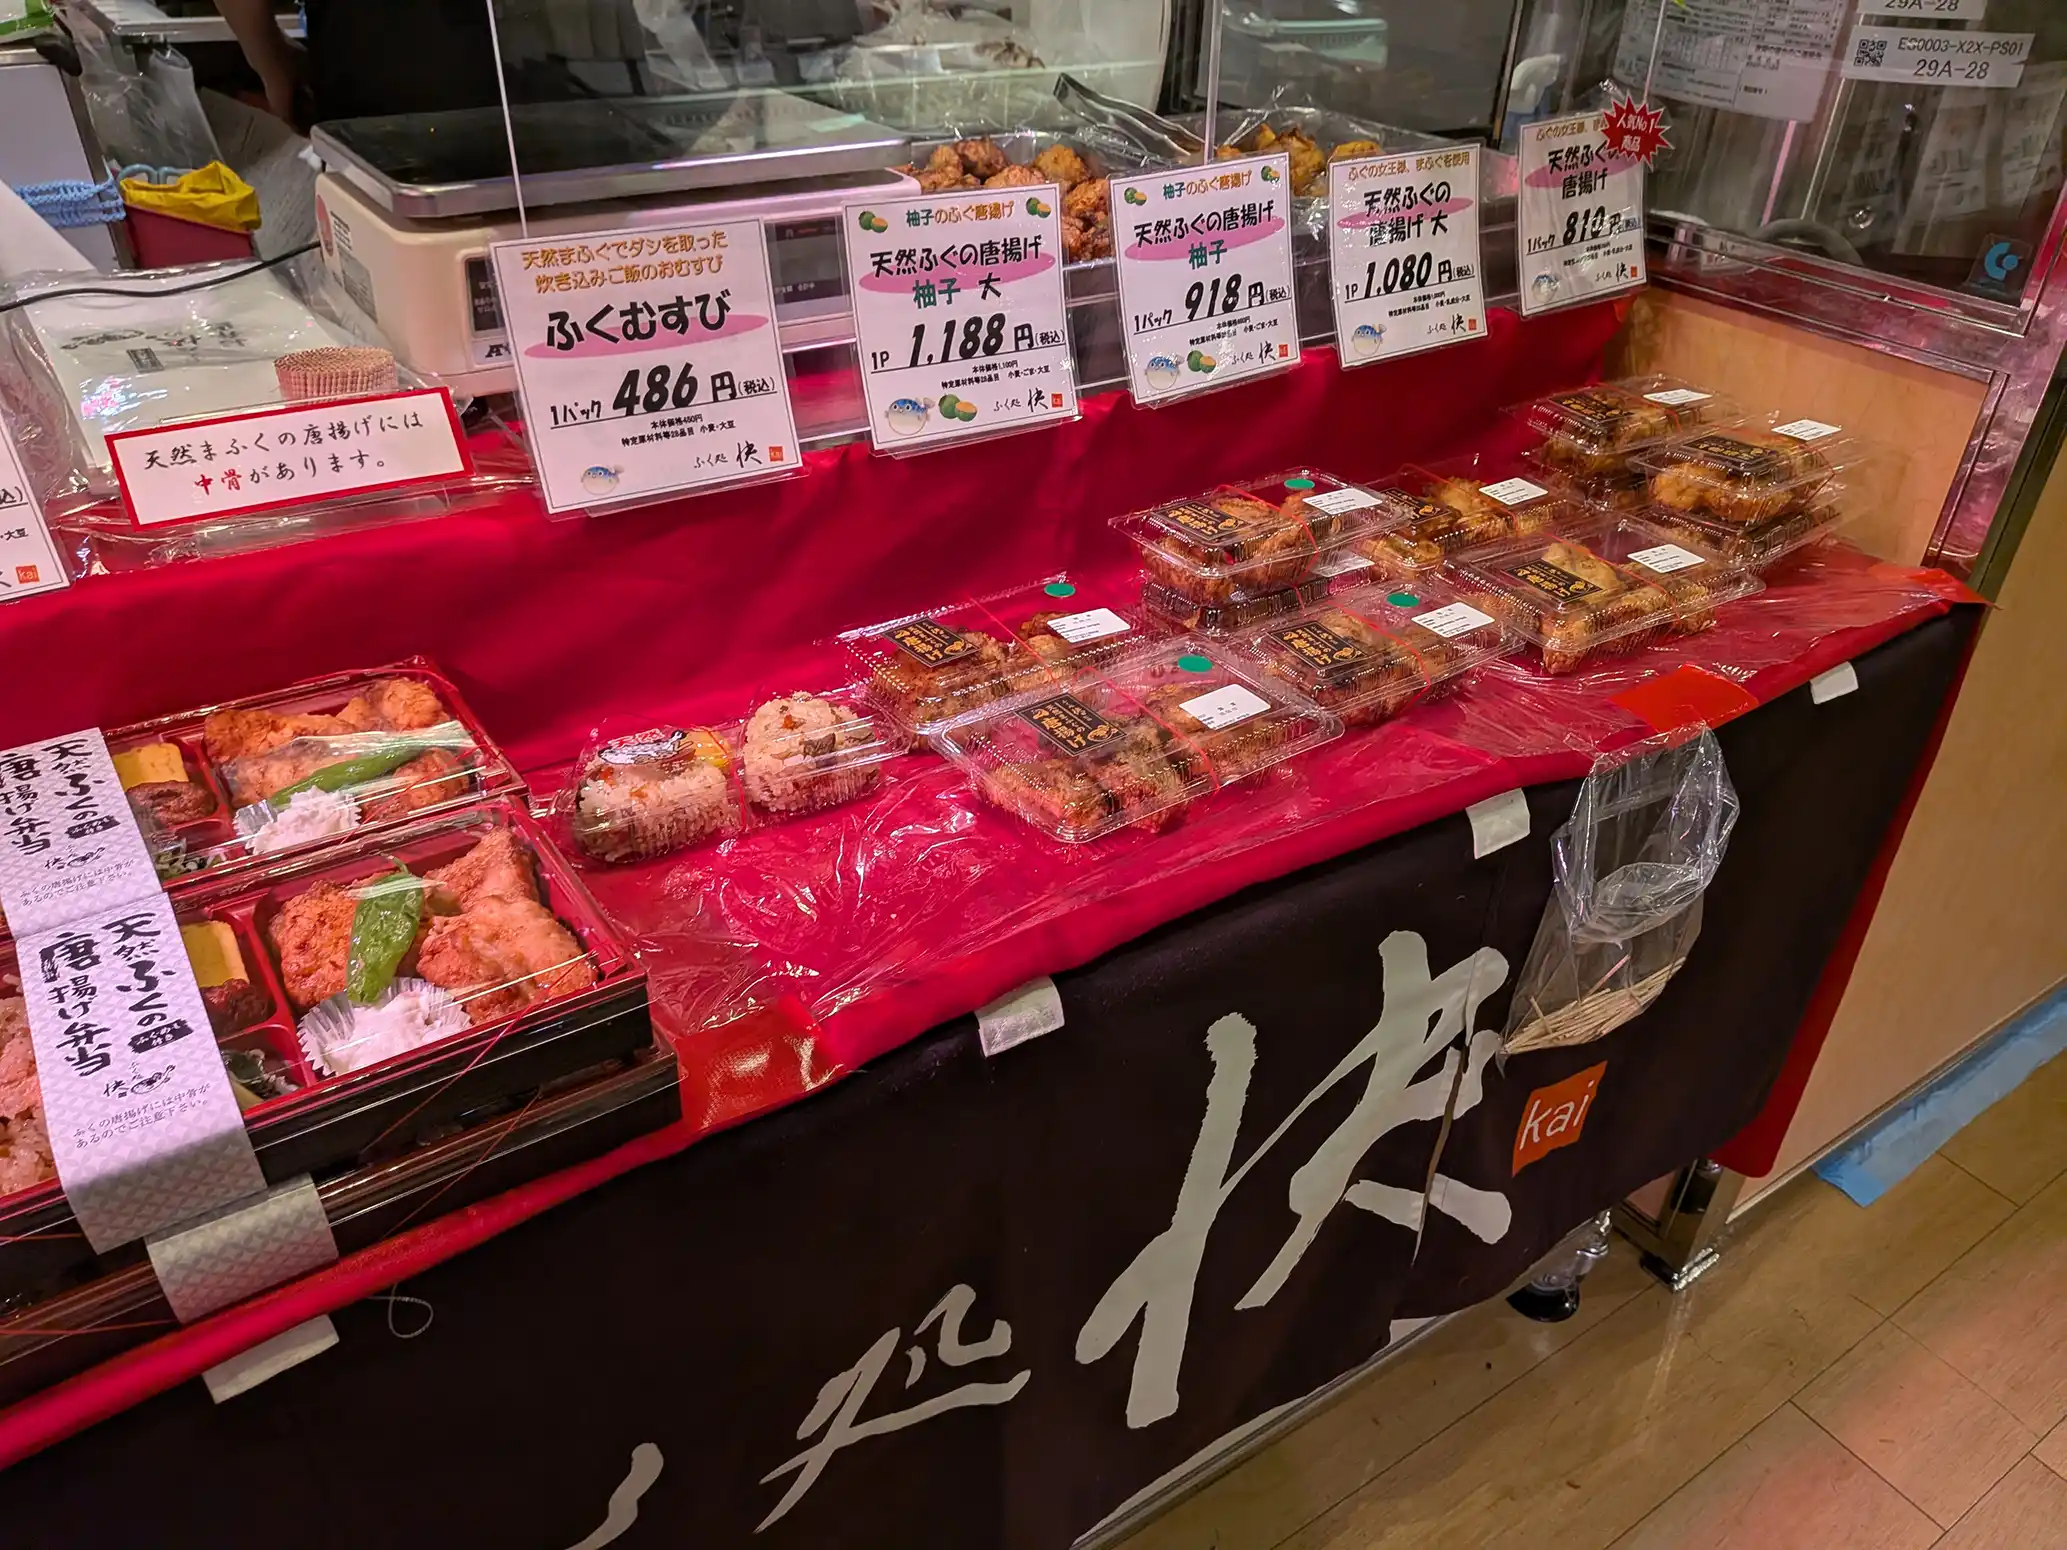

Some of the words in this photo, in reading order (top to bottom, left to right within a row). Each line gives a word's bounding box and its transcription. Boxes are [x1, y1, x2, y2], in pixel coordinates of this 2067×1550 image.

[1914, 59, 1990, 80] 29A-28
[1621, 135, 1641, 152] 商品
[1163, 171, 1253, 200] 柚子のふぐ唐揚げ
[1364, 181, 1451, 217] 天然ふぐの
[1562, 168, 1608, 199] 唐揚げ
[906, 201, 1014, 227] 柚子のふぐ唐揚げ
[1134, 200, 1274, 248] 天然ふぐの唐揚げ
[1431, 210, 1448, 235] 大
[1528, 234, 1555, 252] 1パック
[1563, 205, 1605, 246] 810
[521, 230, 729, 270] 天然まふぐでダシを取った
[870, 235, 1042, 278] 天然ふぐの唐揚げ
[1188, 239, 1228, 269] 柚子
[535, 253, 723, 293] 炊き込みご飯のおむすび
[912, 278, 961, 309] 柚子
[979, 273, 1001, 300] 大
[1345, 283, 1358, 299] 1P
[547, 288, 731, 350] ふくむすび
[1134, 309, 1172, 331] 1パック
[1185, 273, 1242, 321] 918
[872, 351, 889, 370] 1P
[910, 313, 1006, 367] 1,188
[1259, 341, 1276, 364] 快
[551, 400, 601, 425] 1パック
[612, 362, 698, 417] 486
[1028, 387, 1048, 412] 快
[144, 412, 423, 471] 天然まふくの唐揚げには
[700, 420, 736, 434] 小麦・大豆
[194, 450, 385, 496] 中骨があります。
[736, 440, 762, 468] 快
[18, 568, 40, 582] kai
[40, 739, 105, 820] 天然ふくの
[101, 912, 177, 1026] 天然ふくの
[40, 932, 112, 1077] 唐揚げ弁当
[73, 1083, 210, 1137] ふくの唐揚げには中骨が
[76, 1100, 208, 1148] あるのでご注意下さい。
[1520, 1080, 1595, 1150] kai
[1076, 930, 1512, 1428] 快
